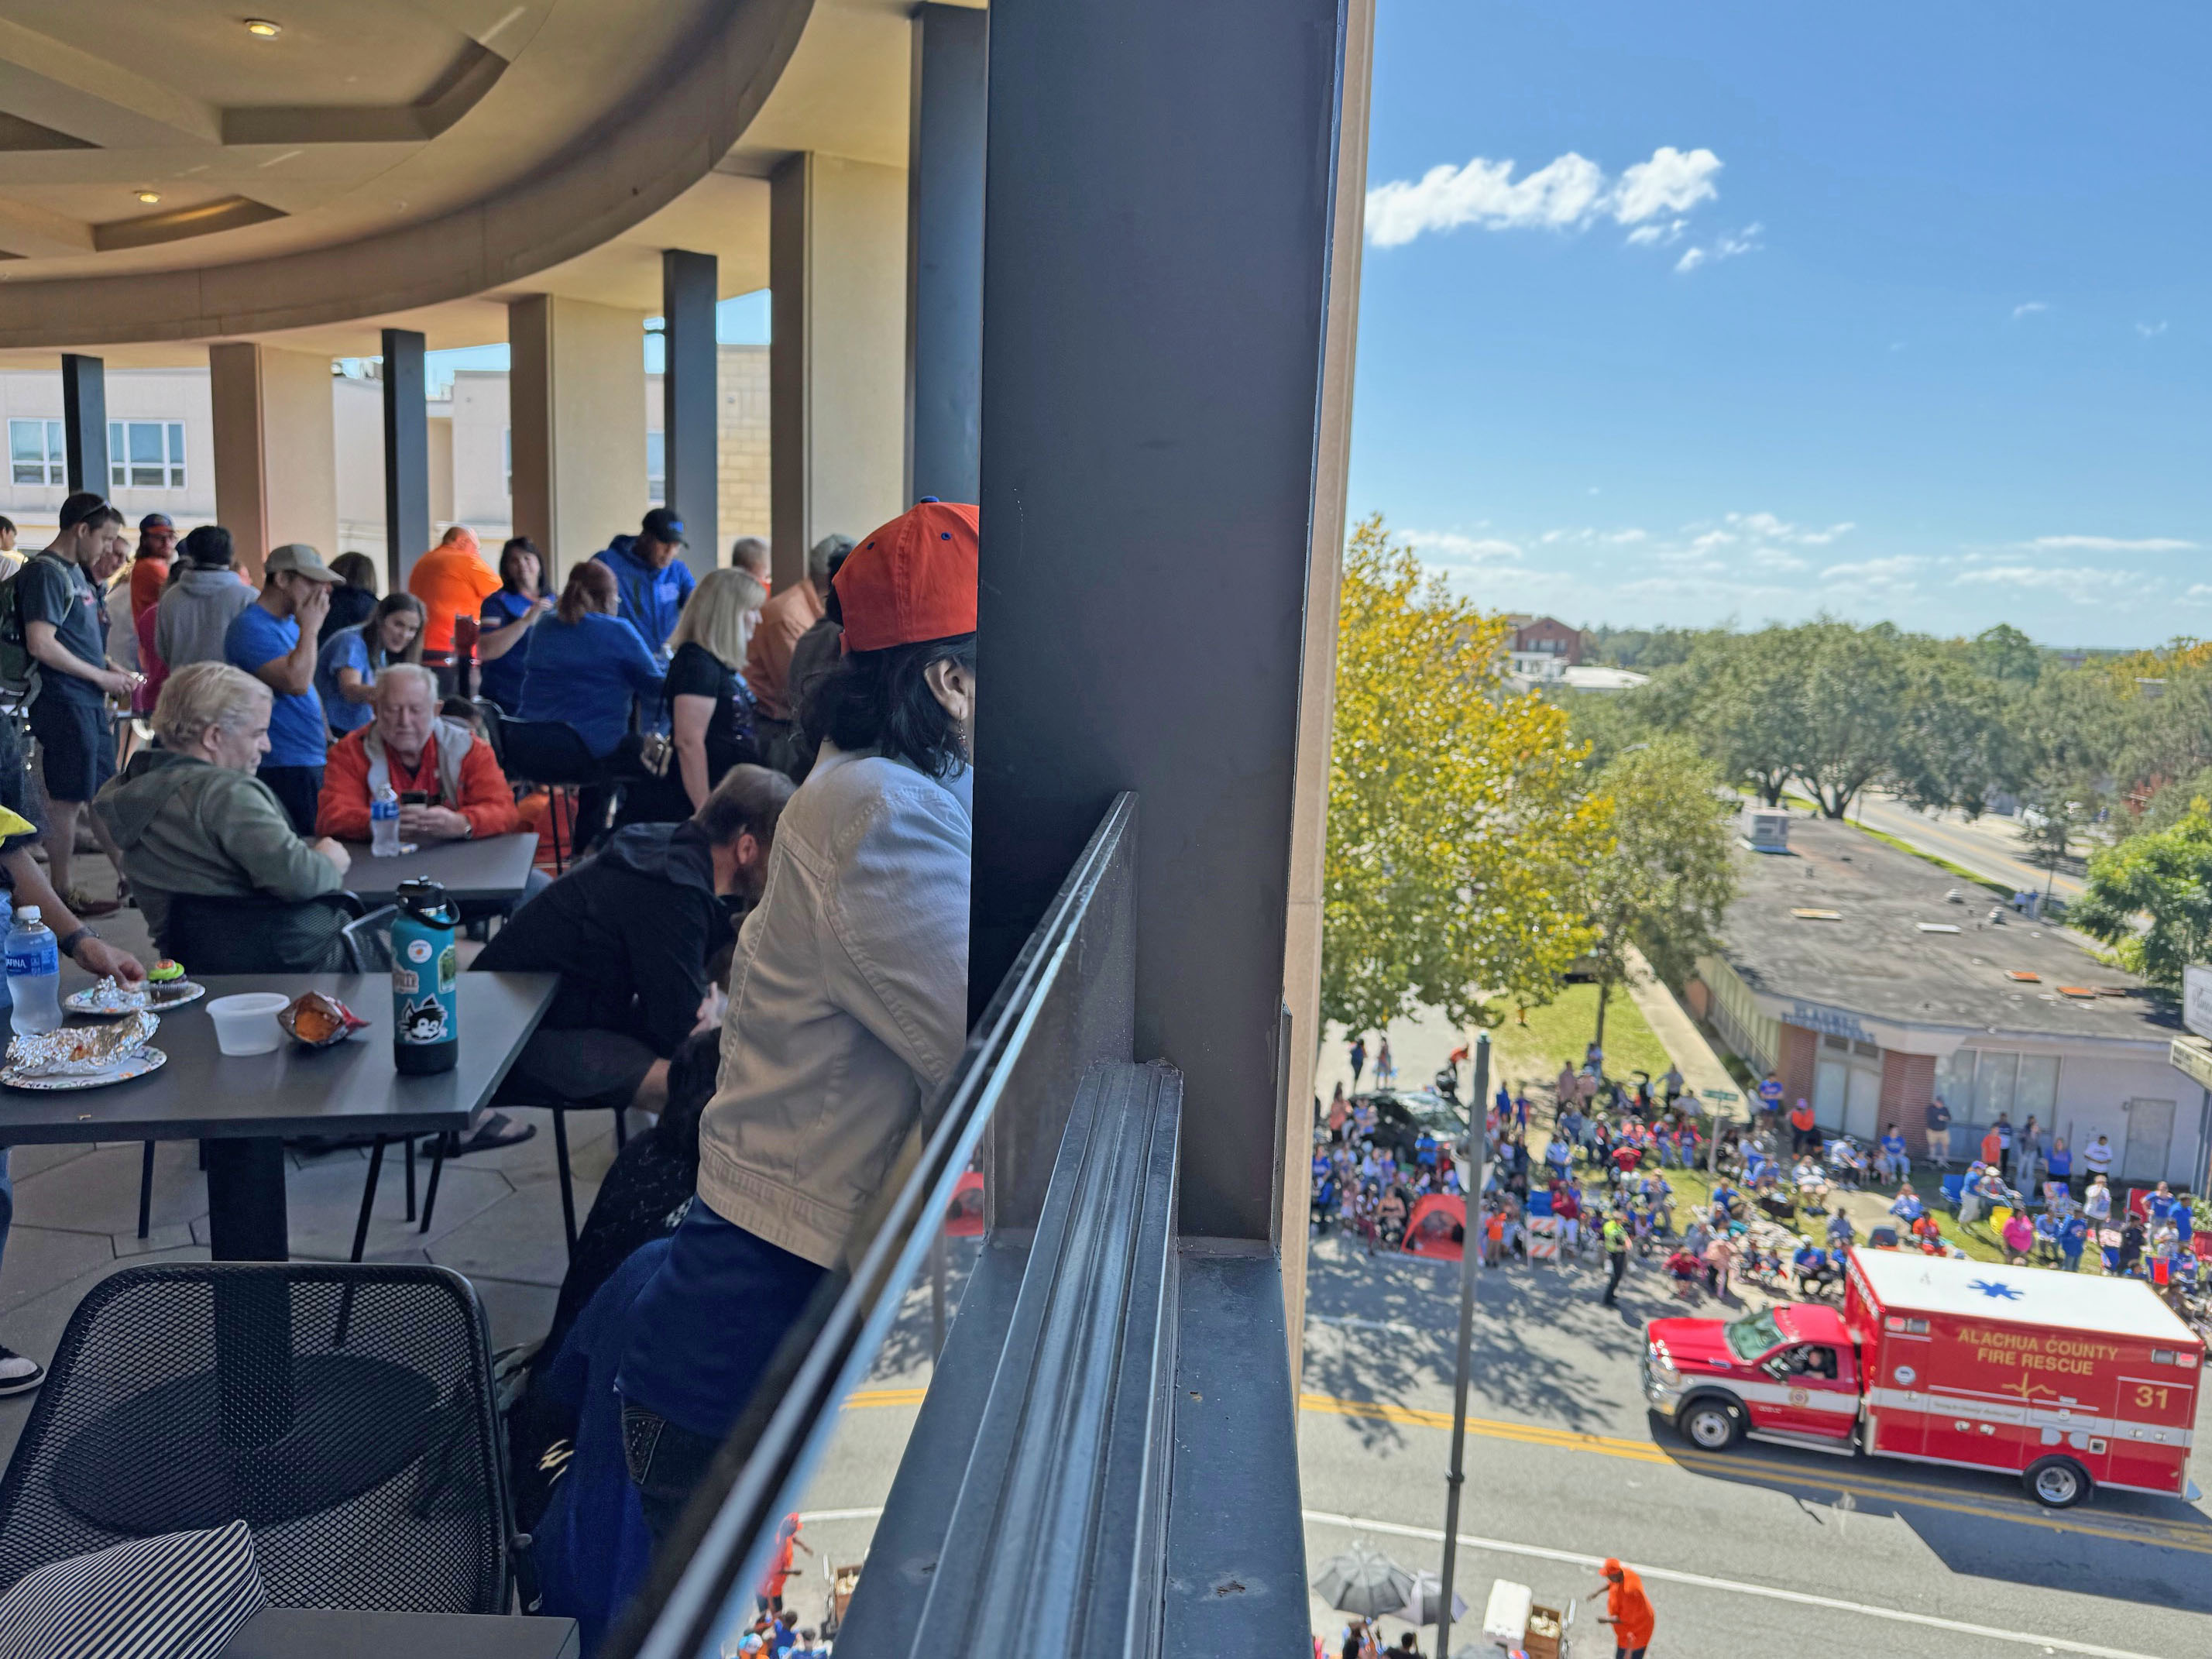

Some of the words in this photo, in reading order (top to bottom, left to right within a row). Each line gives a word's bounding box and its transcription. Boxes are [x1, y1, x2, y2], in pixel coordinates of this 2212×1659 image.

[1958, 1328, 2039, 1352] ALACHUA
[2045, 1338, 2118, 1362] COUNTY
[1977, 1348, 2016, 1366] FIRE
[2021, 1353, 2094, 1376] RESCUE
[2135, 1386, 2168, 1410] 31
